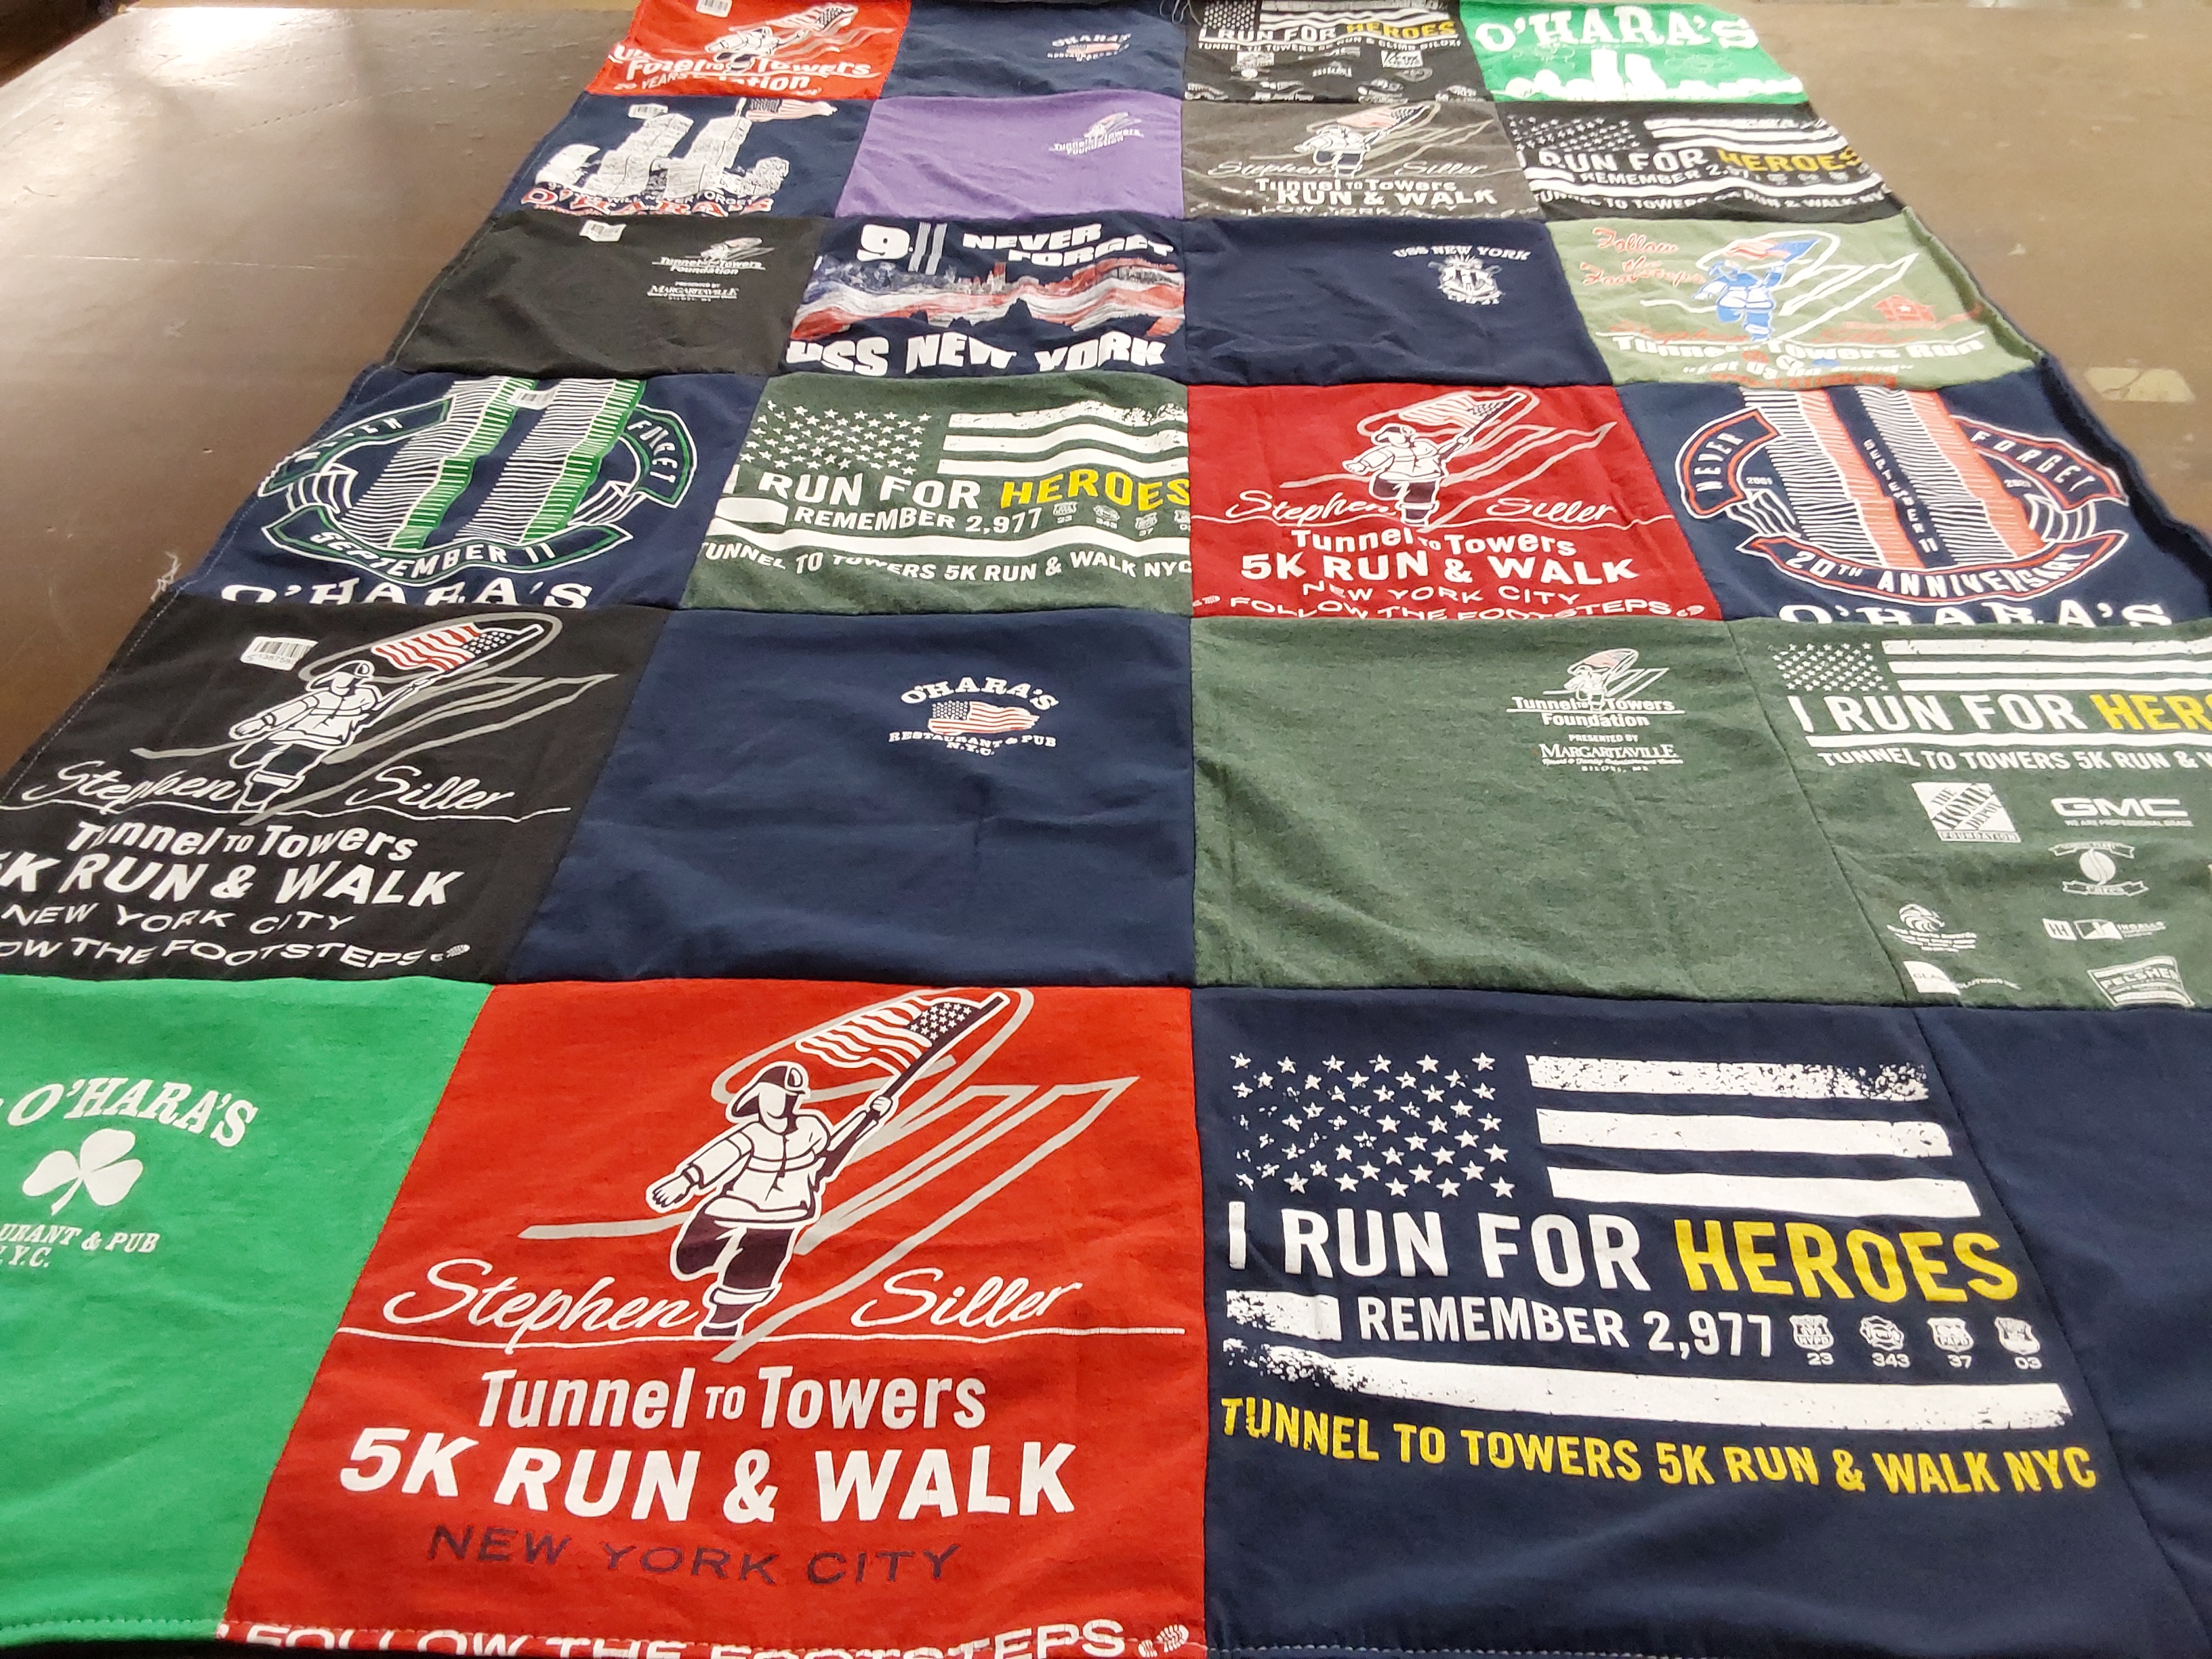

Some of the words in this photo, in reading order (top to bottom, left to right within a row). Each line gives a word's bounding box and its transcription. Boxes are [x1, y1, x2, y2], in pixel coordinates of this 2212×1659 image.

[1218, 28, 1273, 41] RUN
[1285, 25, 1336, 42] FOR
[1346, 22, 1456, 39] HEROES
[1475, 5, 1759, 52] O'HARA'S
[1395, 161, 1488, 176] Siller
[1539, 150, 1618, 172] RUN
[1628, 148, 1709, 171] FOR
[1717, 146, 1863, 171] HEROES
[1255, 178, 1340, 193] Tunnel
[1366, 179, 1456, 191] Towers
[1580, 169, 1702, 185] REMEMBER
[1277, 189, 1353, 206] RUN
[1364, 190, 1385, 206] &
[1395, 188, 1498, 205] WALK
[1603, 197, 1628, 209] TO
[962, 224, 1102, 250] NEVER
[1008, 234, 1174, 266] FORGET
[1431, 245, 1473, 255] NEW
[1477, 246, 1532, 261] YORK
[670, 264, 739, 274] Foundation
[905, 332, 1017, 374] NEW
[1034, 331, 1166, 372] YORK
[1767, 340, 1901, 360] Towers
[1906, 339, 1984, 359] Run
[1694, 432, 1744, 492] NEVER
[1969, 430, 2097, 493] FORGET
[722, 464, 740, 494] I
[758, 472, 863, 506] RUN
[880, 475, 981, 510] FOR
[1000, 468, 1190, 511] HEROES
[794, 506, 956, 531] REMEMBER
[965, 508, 1042, 534] 2,977
[1225, 489, 1399, 524] Stephen
[1486, 497, 1618, 523] Siller
[310, 531, 508, 580] SEPTEMBER
[1290, 528, 1414, 553] Tunnel
[1420, 537, 1439, 551] TO
[1449, 533, 1578, 557] Towers
[1919, 537, 1939, 553] 11
[702, 541, 787, 570] TUNNEL
[796, 552, 824, 574] TO
[832, 553, 937, 579] TOWERS
[943, 564, 977, 581] 5K
[983, 562, 1037, 582] RUN
[1045, 556, 1063, 577] &
[1069, 550, 1137, 578] WALK
[1143, 559, 1191, 577] NYC
[1240, 551, 1307, 581] 5K
[1322, 549, 1427, 582] RUN
[1444, 557, 1473, 585] &
[1491, 555, 1640, 586] WALK
[1785, 551, 1862, 577] 20TH
[1877, 554, 2091, 599] ANNIVERSARY
[222, 577, 592, 609] O'HARA'S
[1301, 581, 1374, 602] NEW
[1387, 584, 1485, 605] YORK
[1496, 583, 1581, 606] CITY
[1229, 596, 1369, 620] FOLLOW
[1377, 605, 1452, 621] THE
[1457, 597, 1673, 622] FOOTSTEPS
[1778, 599, 2173, 628] O'HARA'S
[901, 677, 1059, 710] O'HARA'S
[1511, 696, 1578, 711] Tunnel
[1605, 697, 1675, 712] Towers
[1541, 712, 1651, 728] Foundation
[1786, 695, 1815, 733] I
[1824, 695, 1954, 733] RUN
[1960, 693, 2089, 731] FOR
[2089, 693, 2212, 731] HER
[888, 731, 1003, 749] RESTAURANT
[1021, 734, 1057, 747] PUB
[1539, 743, 1678, 759] MARGARITAVILLE
[1568, 734, 1623, 743] PRESENTED
[1625, 734, 1639, 743] BY
[1816, 747, 1921, 767] TUNNEL
[1921, 750, 1959, 770] TO
[1959, 751, 2070, 771] TOWERS
[2076, 750, 2112, 769] 5K
[2111, 751, 2171, 770] RUN
[2173, 751, 2199, 769] &
[22, 760, 240, 813] Stephen
[346, 764, 516, 811] Siller
[2051, 797, 2189, 817] GMC
[66, 821, 226, 857] Tunnel
[222, 834, 255, 853] TO
[258, 825, 419, 861] Towers
[58, 853, 209, 902] RUN
[210, 864, 257, 899] &
[274, 859, 466, 908] WALK
[1, 902, 100, 927] NEW
[116, 904, 237, 933] YORK
[249, 913, 356, 933] CITY
[71, 937, 157, 965] THE
[161, 939, 425, 970] FOOTSTEPS
[7, 1078, 259, 1147] O'HARA'S
[81, 1231, 103, 1250] &
[104, 1232, 161, 1253] PUB
[1227, 1201, 1246, 1270] I
[1282, 1208, 1448, 1279] RUN
[1478, 1214, 1650, 1292] FOR
[1674, 1219, 2019, 1303] HEROES
[383, 1258, 701, 1355] Stephen
[851, 1267, 1084, 1327] Siller
[1359, 1294, 1628, 1349] REMEMBER
[1643, 1310, 1772, 1359] 2,977
[1807, 1352, 1835, 1366] 23
[1872, 1353, 1911, 1368] 343
[1947, 1355, 1972, 1369] 37
[2014, 1355, 2043, 1370] 03
[478, 1367, 694, 1429] Tunnel
[704, 1386, 744, 1421] TO
[758, 1364, 987, 1430] Towers
[1221, 1397, 1380, 1462] TUNNEL
[1393, 1422, 1446, 1465] TO
[1460, 1429, 1643, 1479] TOWERS
[1658, 1439, 1717, 1485] 5K
[1728, 1446, 1820, 1486] RUN
[1833, 1448, 1864, 1490] &
[1877, 1452, 1995, 1492] WALK
[2009, 1450, 2098, 1490] NYC
[338, 1427, 478, 1499] 5K
[493, 1448, 701, 1522] RUN
[722, 1449, 779, 1523] &
[814, 1442, 1078, 1521] WALK
[426, 1524, 571, 1562] NEW
[605, 1544, 778, 1584] YORK
[805, 1544, 960, 1584] CITY
[247, 1626, 529, 1658] FOLLOW
[545, 1636, 687, 1659] THE
